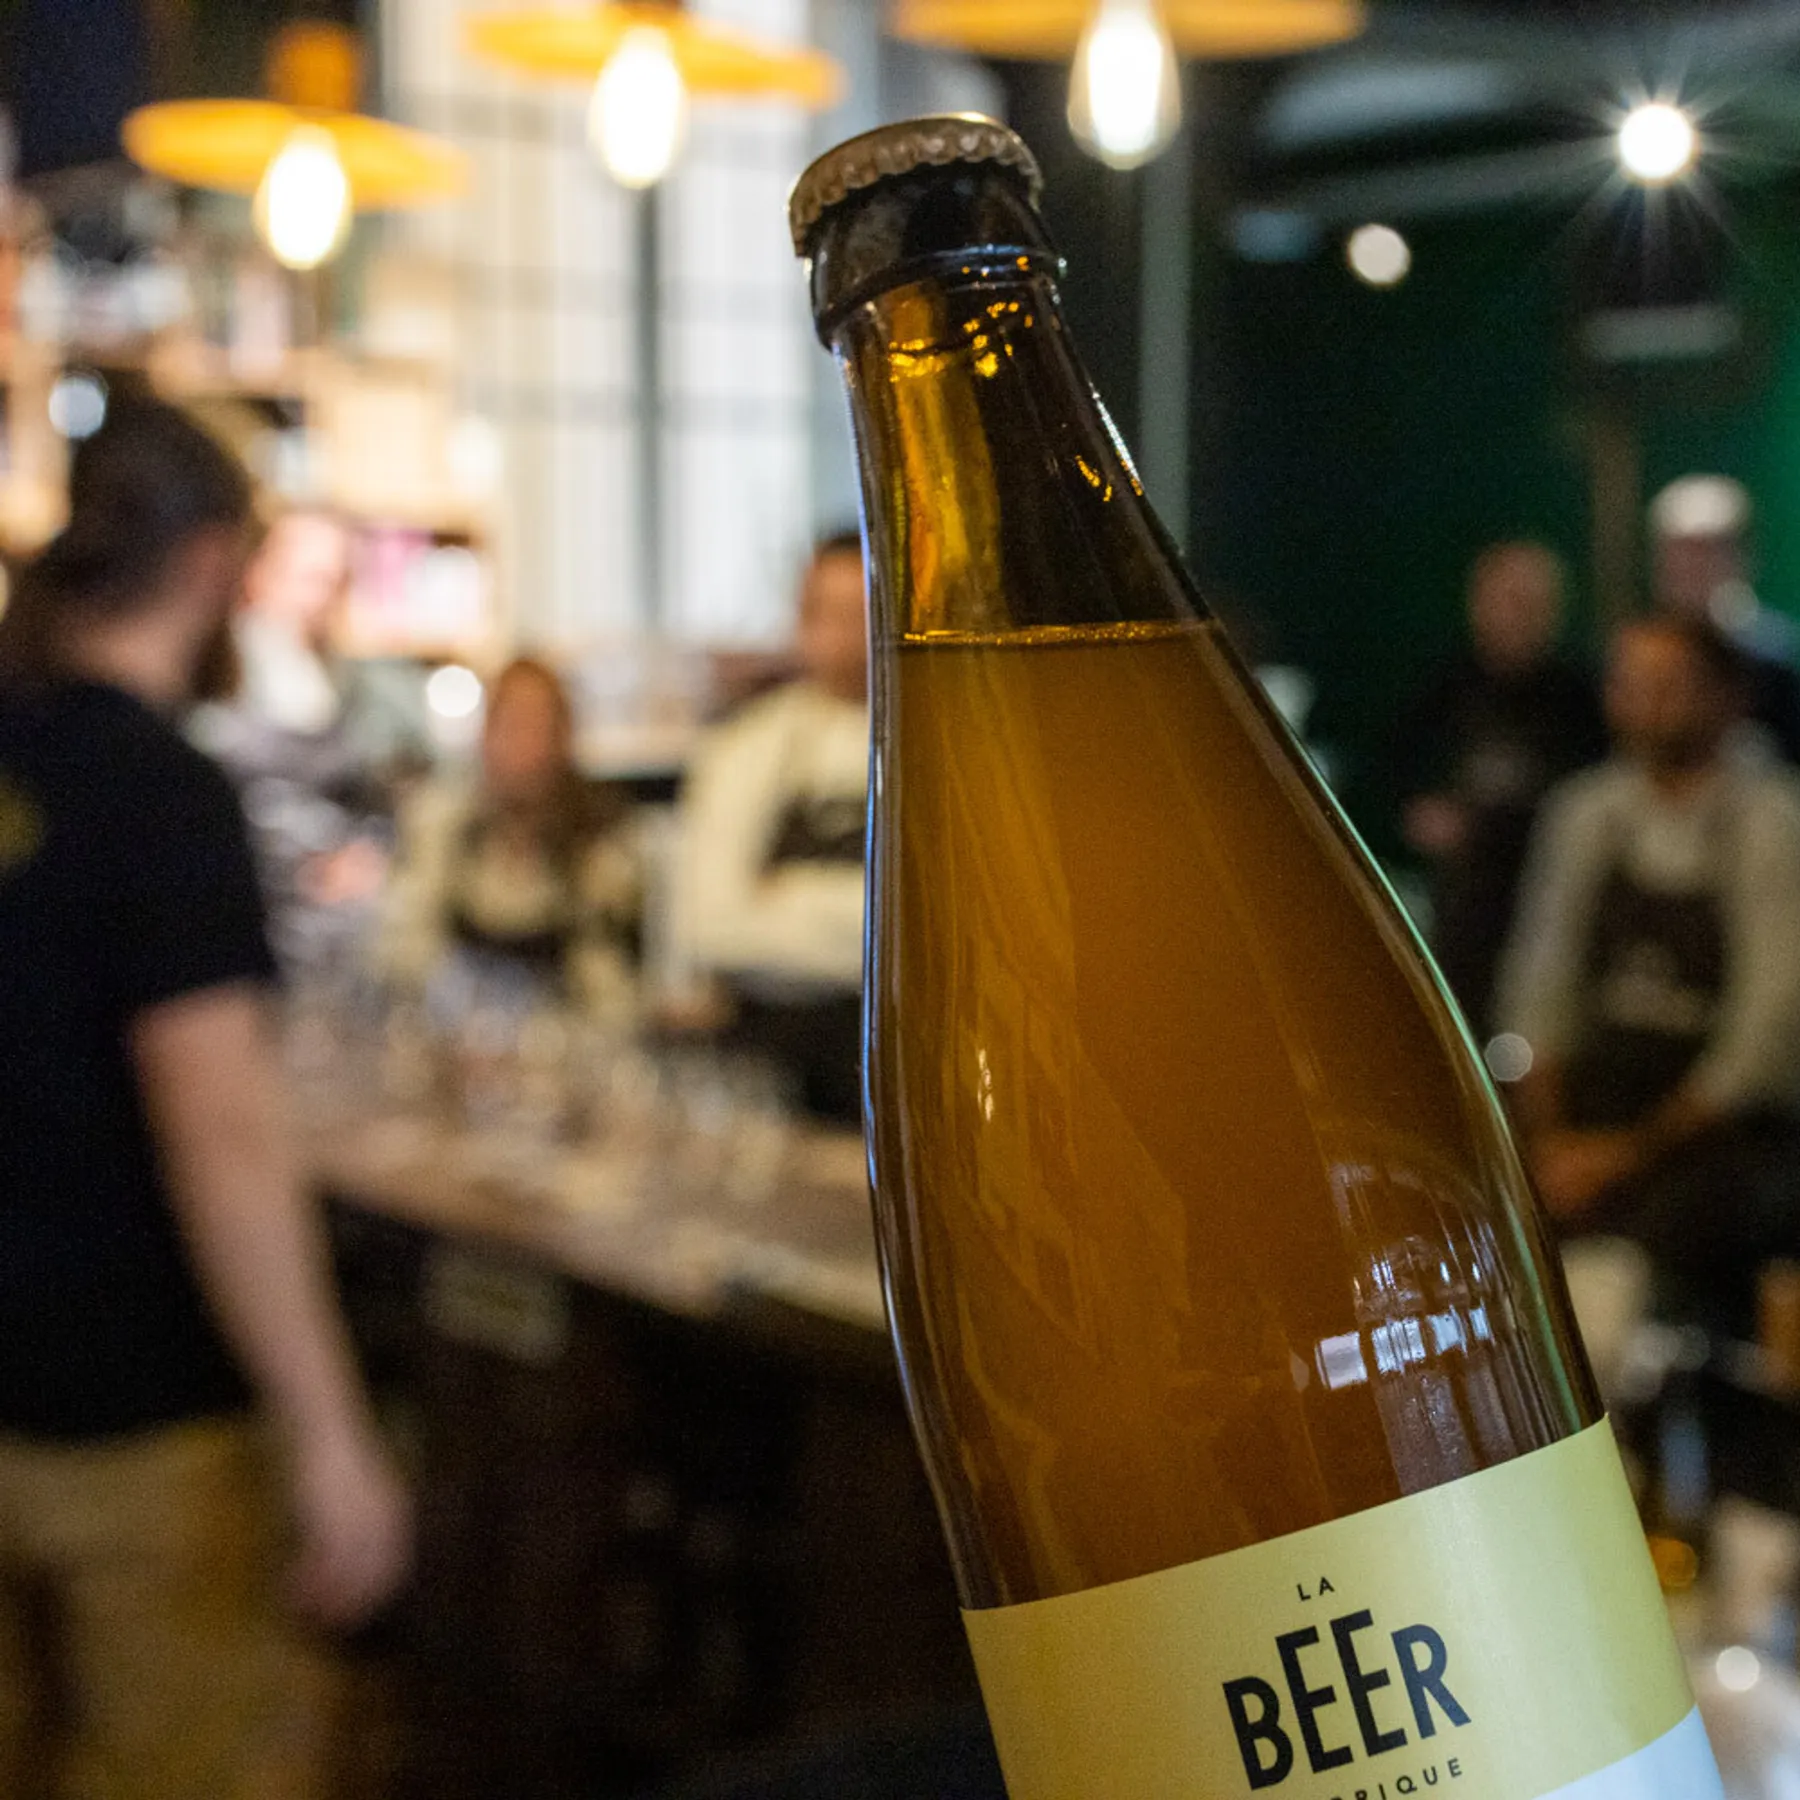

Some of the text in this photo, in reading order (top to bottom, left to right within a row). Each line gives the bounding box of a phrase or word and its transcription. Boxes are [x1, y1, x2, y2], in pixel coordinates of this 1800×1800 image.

[1296, 1576, 1335, 1601] LA
[1222, 1608, 1472, 1791] BEER
[1330, 1758, 1462, 1800] RIQUE
